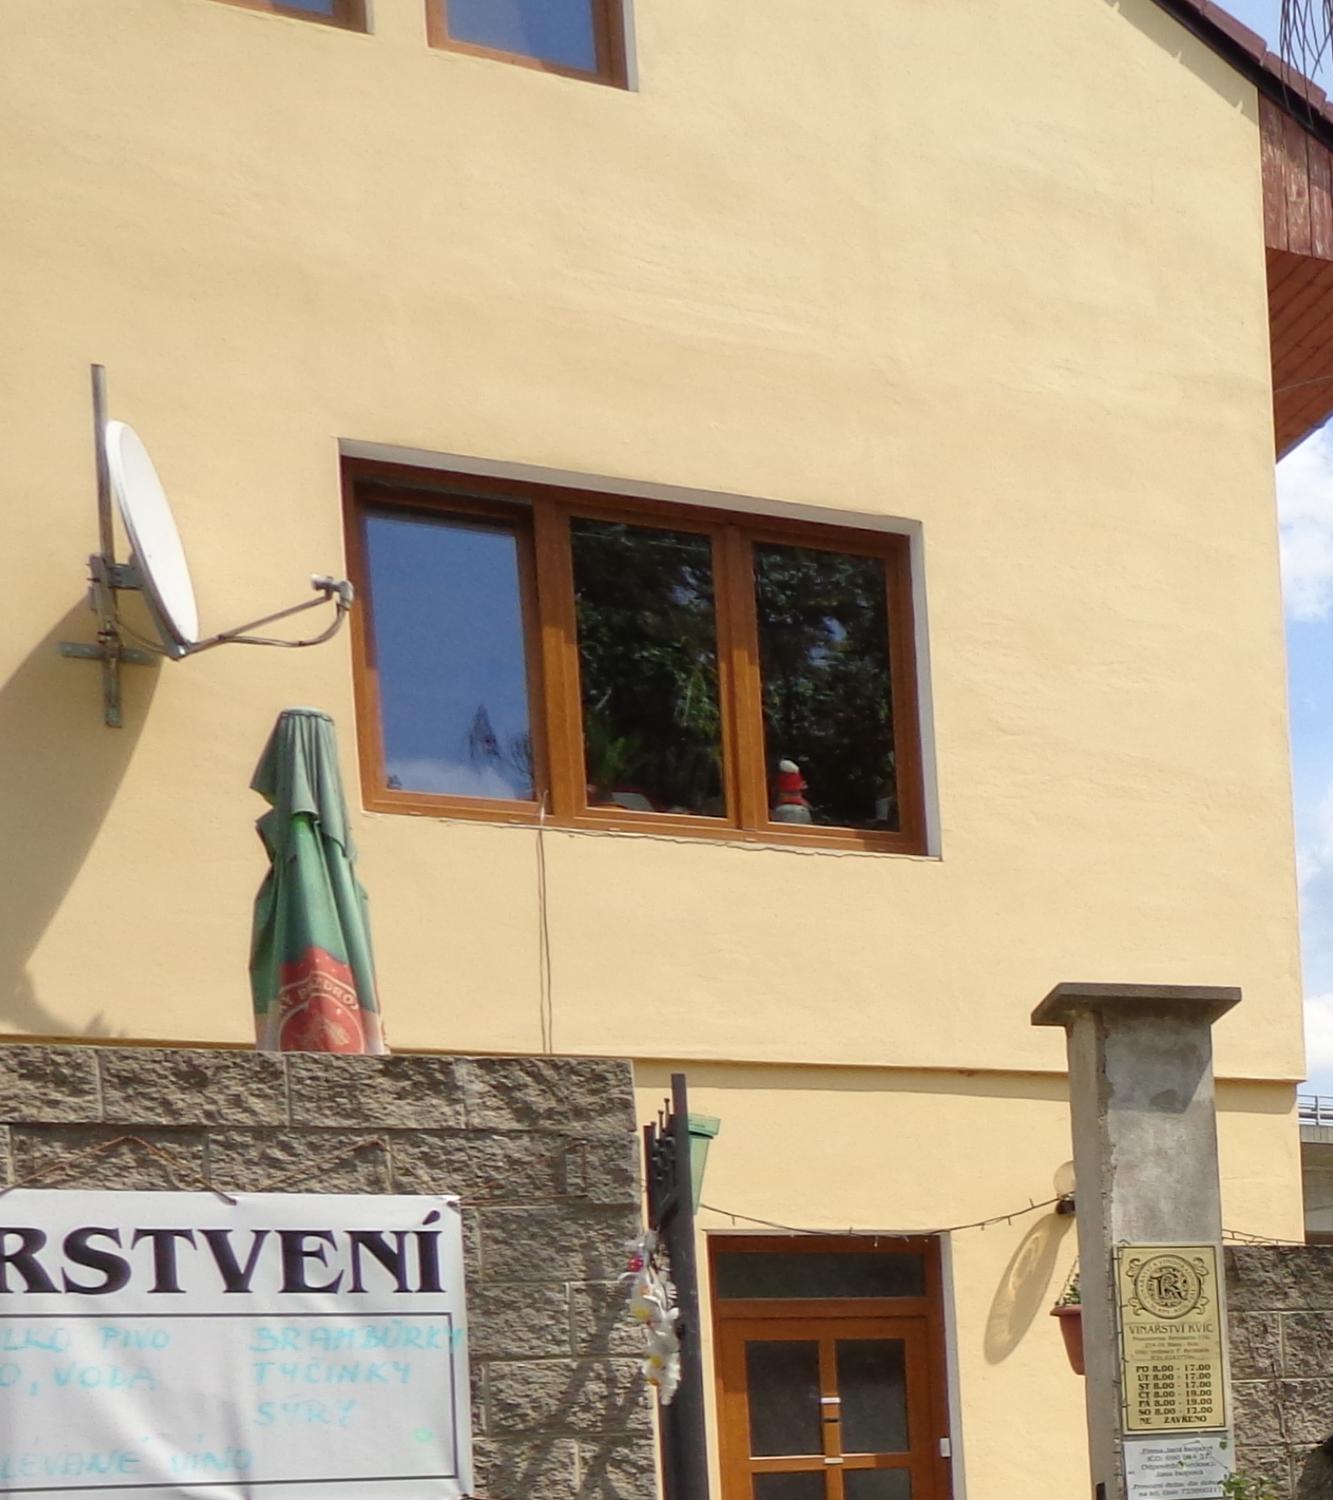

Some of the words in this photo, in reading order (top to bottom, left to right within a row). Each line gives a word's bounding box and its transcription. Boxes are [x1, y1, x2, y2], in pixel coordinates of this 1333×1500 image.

[99, 1325, 170, 1349] PIVO
[53, 1361, 157, 1390] VODA
[1136, 1365, 1149, 1373] PO
